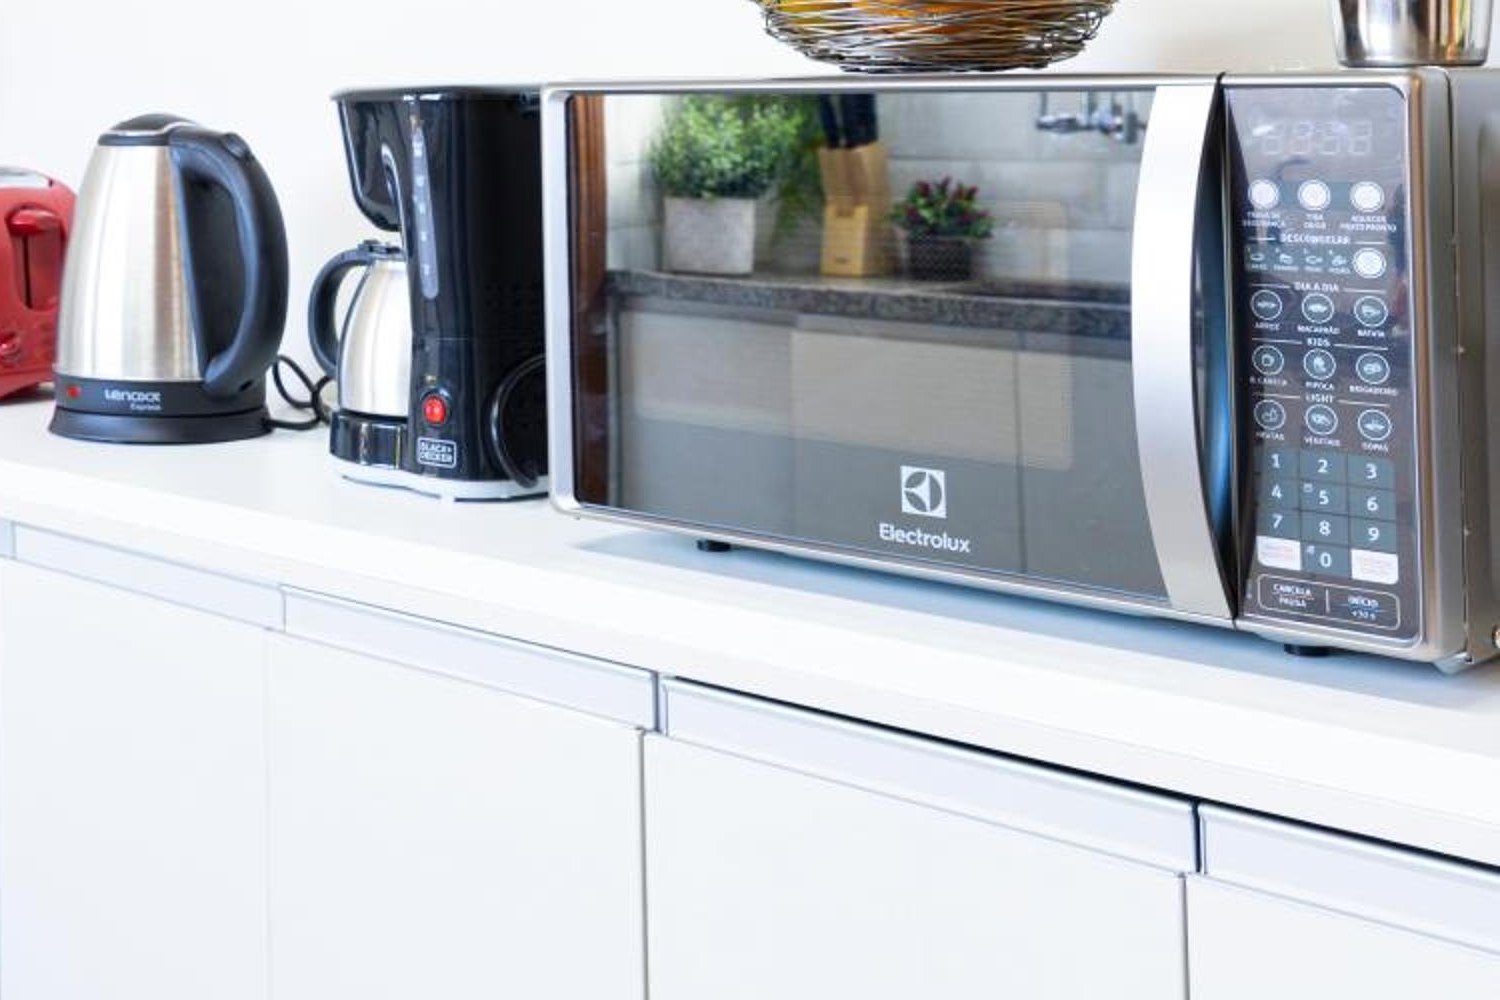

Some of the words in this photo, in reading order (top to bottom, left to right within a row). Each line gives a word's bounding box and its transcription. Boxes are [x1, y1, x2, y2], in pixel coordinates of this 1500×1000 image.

[1307, 338, 1331, 347] KIDS
[1305, 393, 1335, 404] LIGHT
[1271, 454, 1281, 468] 1
[1317, 459, 1329, 473] 2
[1366, 464, 1377, 479] 3
[1271, 486, 1282, 499] 4
[1319, 491, 1329, 505] 5
[1367, 497, 1378, 511] 6
[879, 522, 972, 553] Electrolux
[1272, 515, 1283, 529] 7
[1319, 521, 1331, 536] 8
[1368, 527, 1379, 542] 9
[1320, 553, 1332, 568] 0
